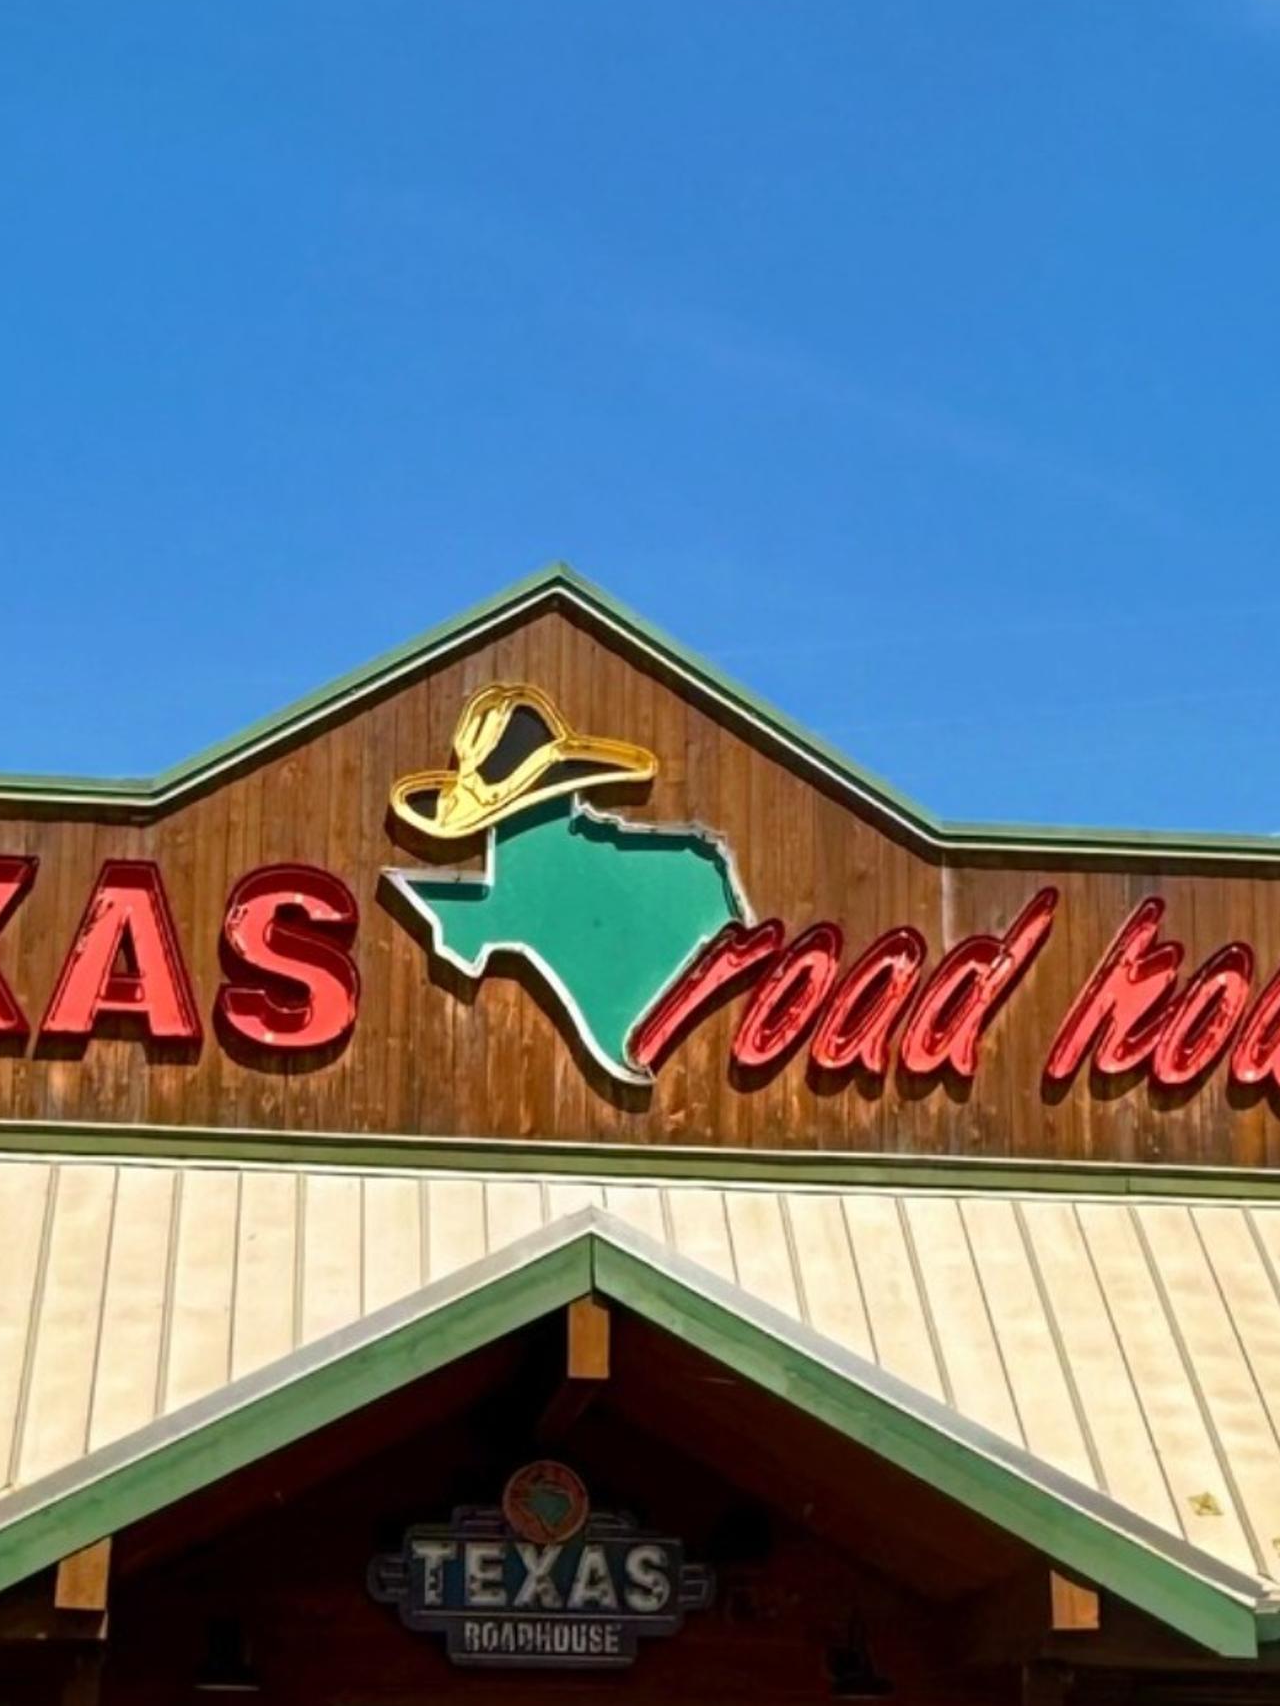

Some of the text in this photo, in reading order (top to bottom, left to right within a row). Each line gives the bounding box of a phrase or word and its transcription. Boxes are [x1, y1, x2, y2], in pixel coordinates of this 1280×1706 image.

[628, 886, 1059, 1076] road
[412, 1541, 671, 1612] TEXAS
[464, 1621, 619, 1653] ROADHOUSE
